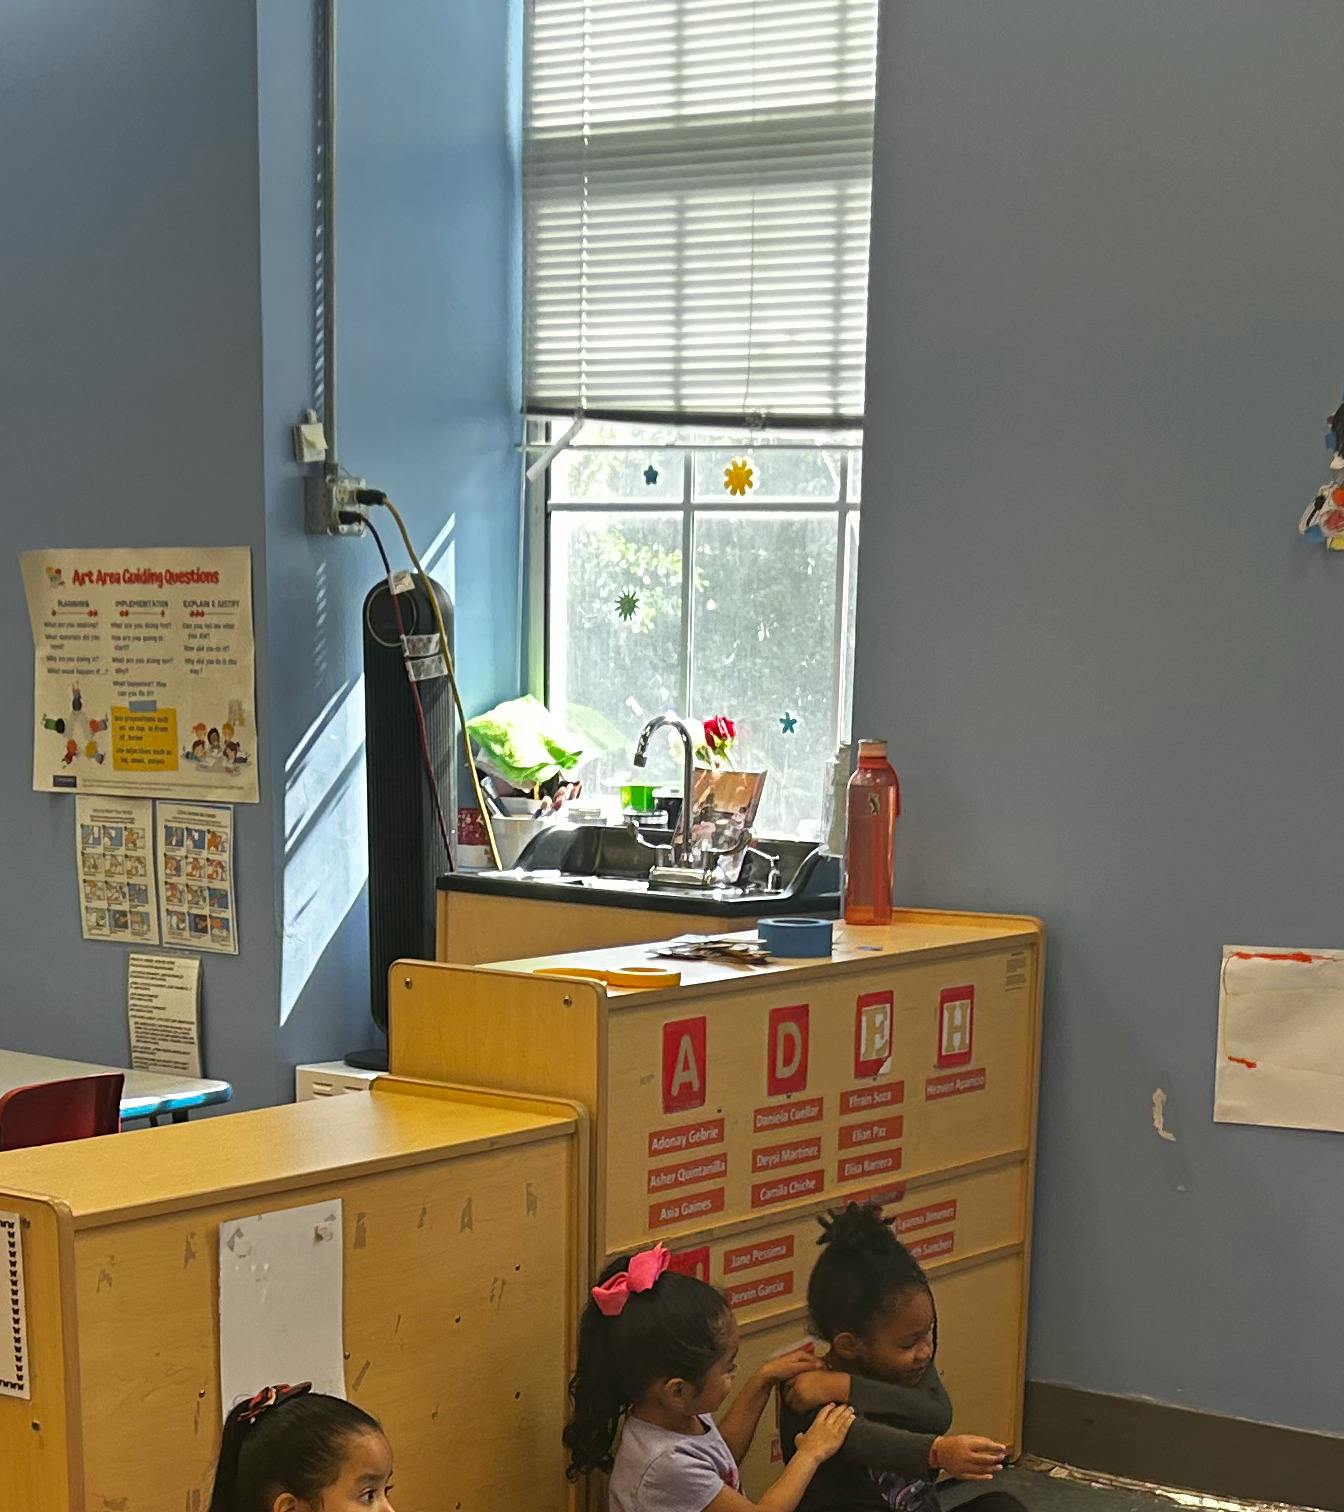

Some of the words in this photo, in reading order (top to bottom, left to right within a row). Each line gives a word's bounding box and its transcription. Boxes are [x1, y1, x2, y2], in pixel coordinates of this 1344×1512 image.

[96, 568, 122, 587] Area
[122, 567, 164, 589] Guiding
[164, 566, 220, 586] Questions
[775, 1021, 803, 1080] D
[861, 1004, 890, 1060] E
[943, 1001, 971, 1055] H
[670, 1034, 700, 1098] A
